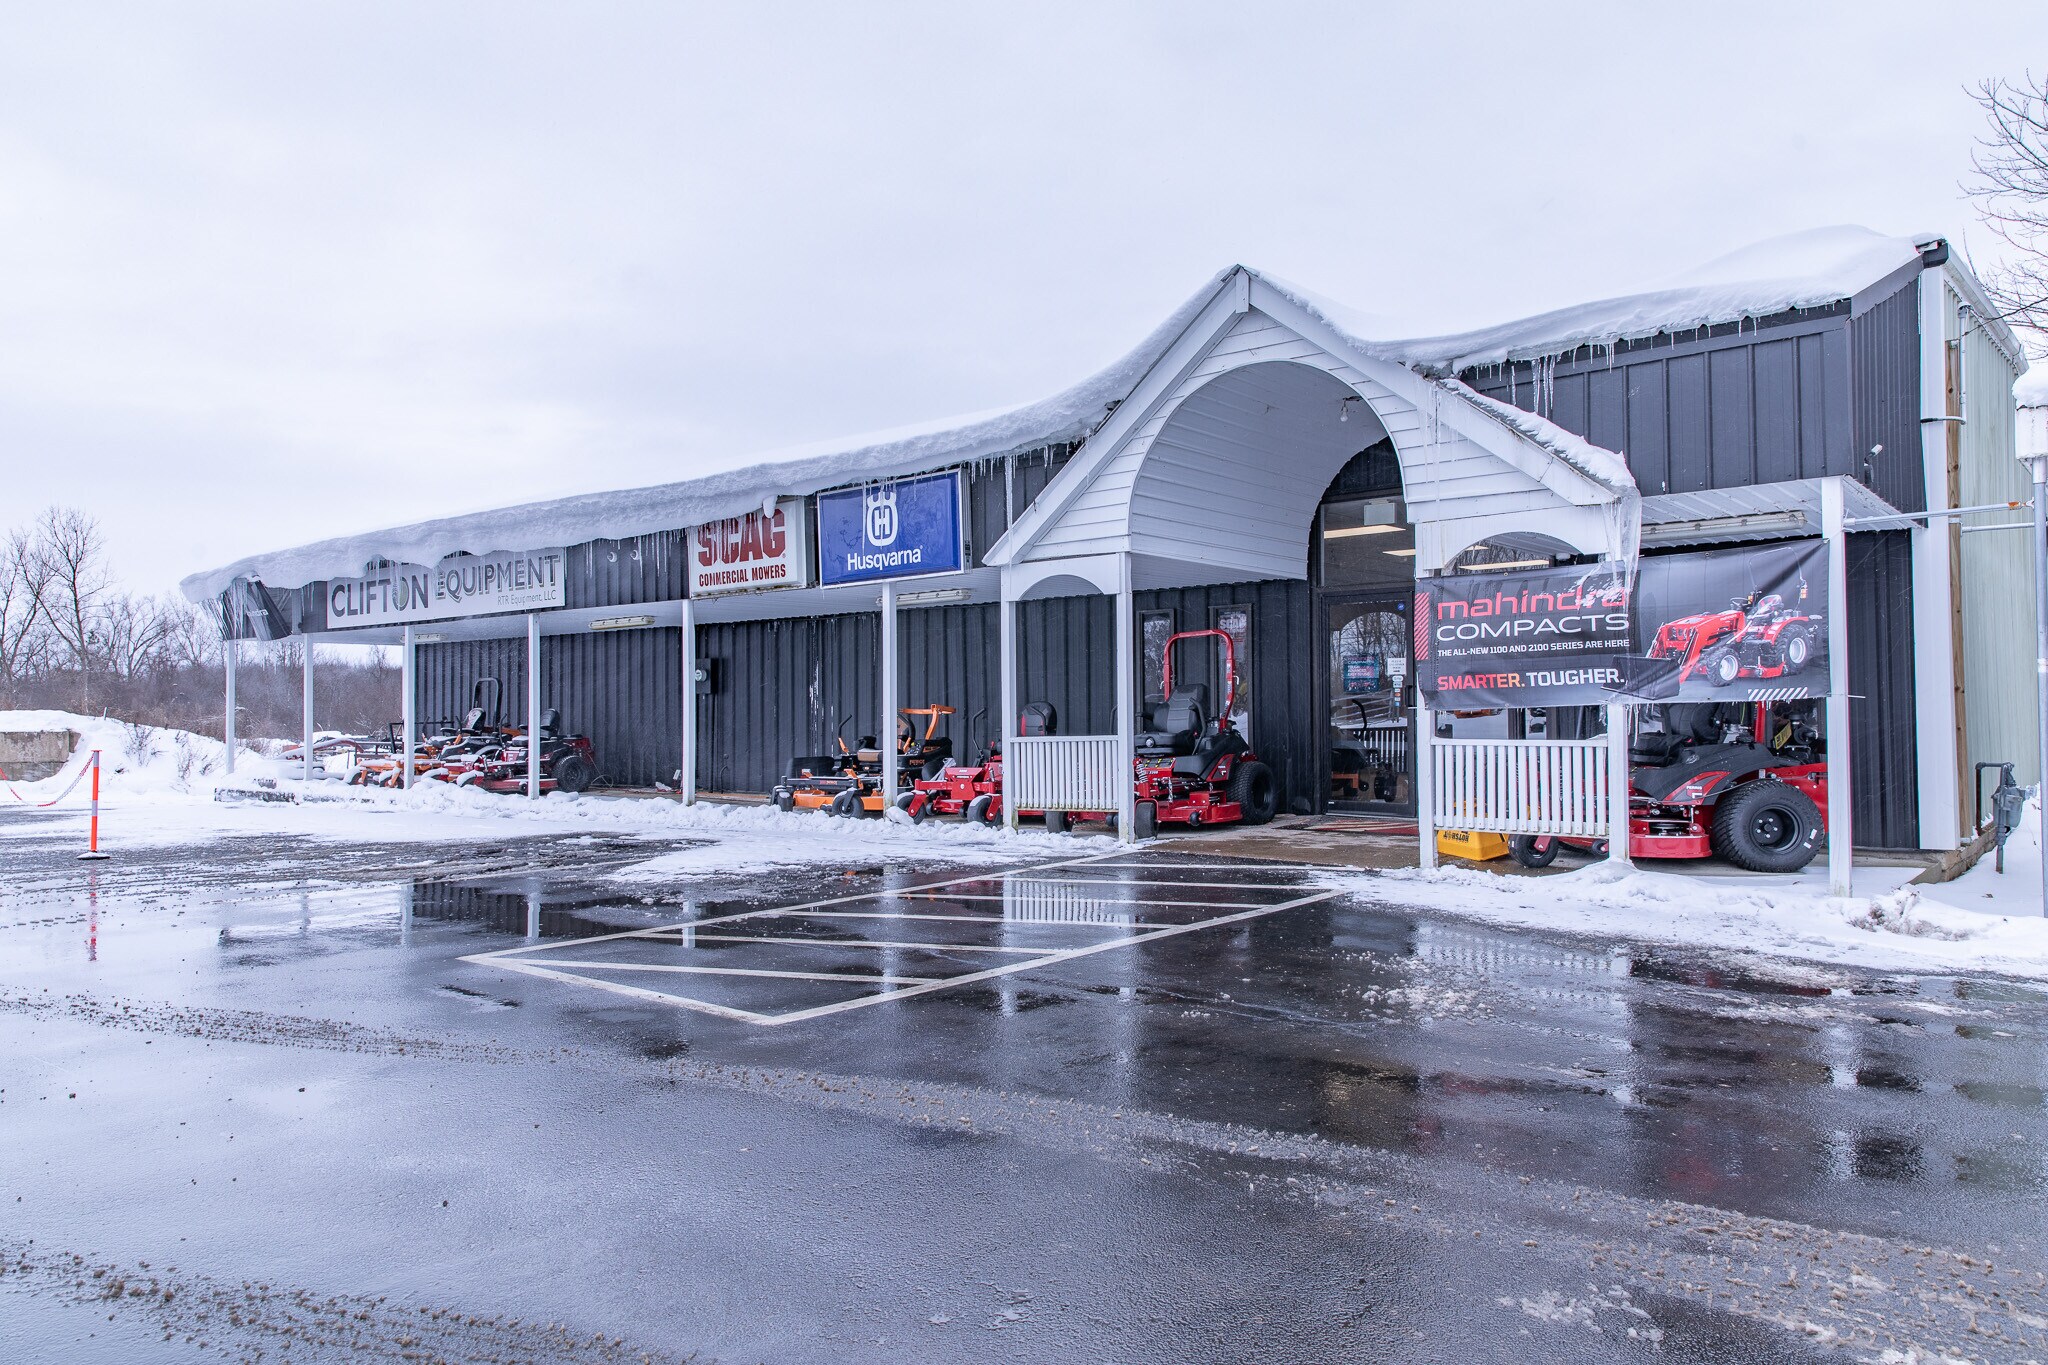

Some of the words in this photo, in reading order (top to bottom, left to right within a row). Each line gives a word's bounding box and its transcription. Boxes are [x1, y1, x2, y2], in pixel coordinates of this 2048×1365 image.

[698, 508, 786, 567] SCAG
[847, 548, 922, 571] Husqvarna
[331, 572, 429, 617] CLIFTON
[436, 554, 561, 603] EQUIPMENT
[698, 568, 749, 587] COMMERCIAL
[751, 563, 787, 581] MOWERS
[544, 589, 557, 601] LLC
[1436, 613, 1630, 642] COMPACTS
[1438, 649, 1452, 657] THE
[1453, 647, 1489, 656] ALL-NEW
[1490, 645, 1508, 654] 1100
[1509, 644, 1527, 653] AND
[1528, 643, 1549, 652] 2100
[1550, 641, 1583, 651] SERIES
[1584, 640, 1603, 649] ARE
[1604, 639, 1630, 648] HERE
[1437, 672, 1525, 691] SMARTER.
[1526, 668, 1625, 687] TOUGHER.
